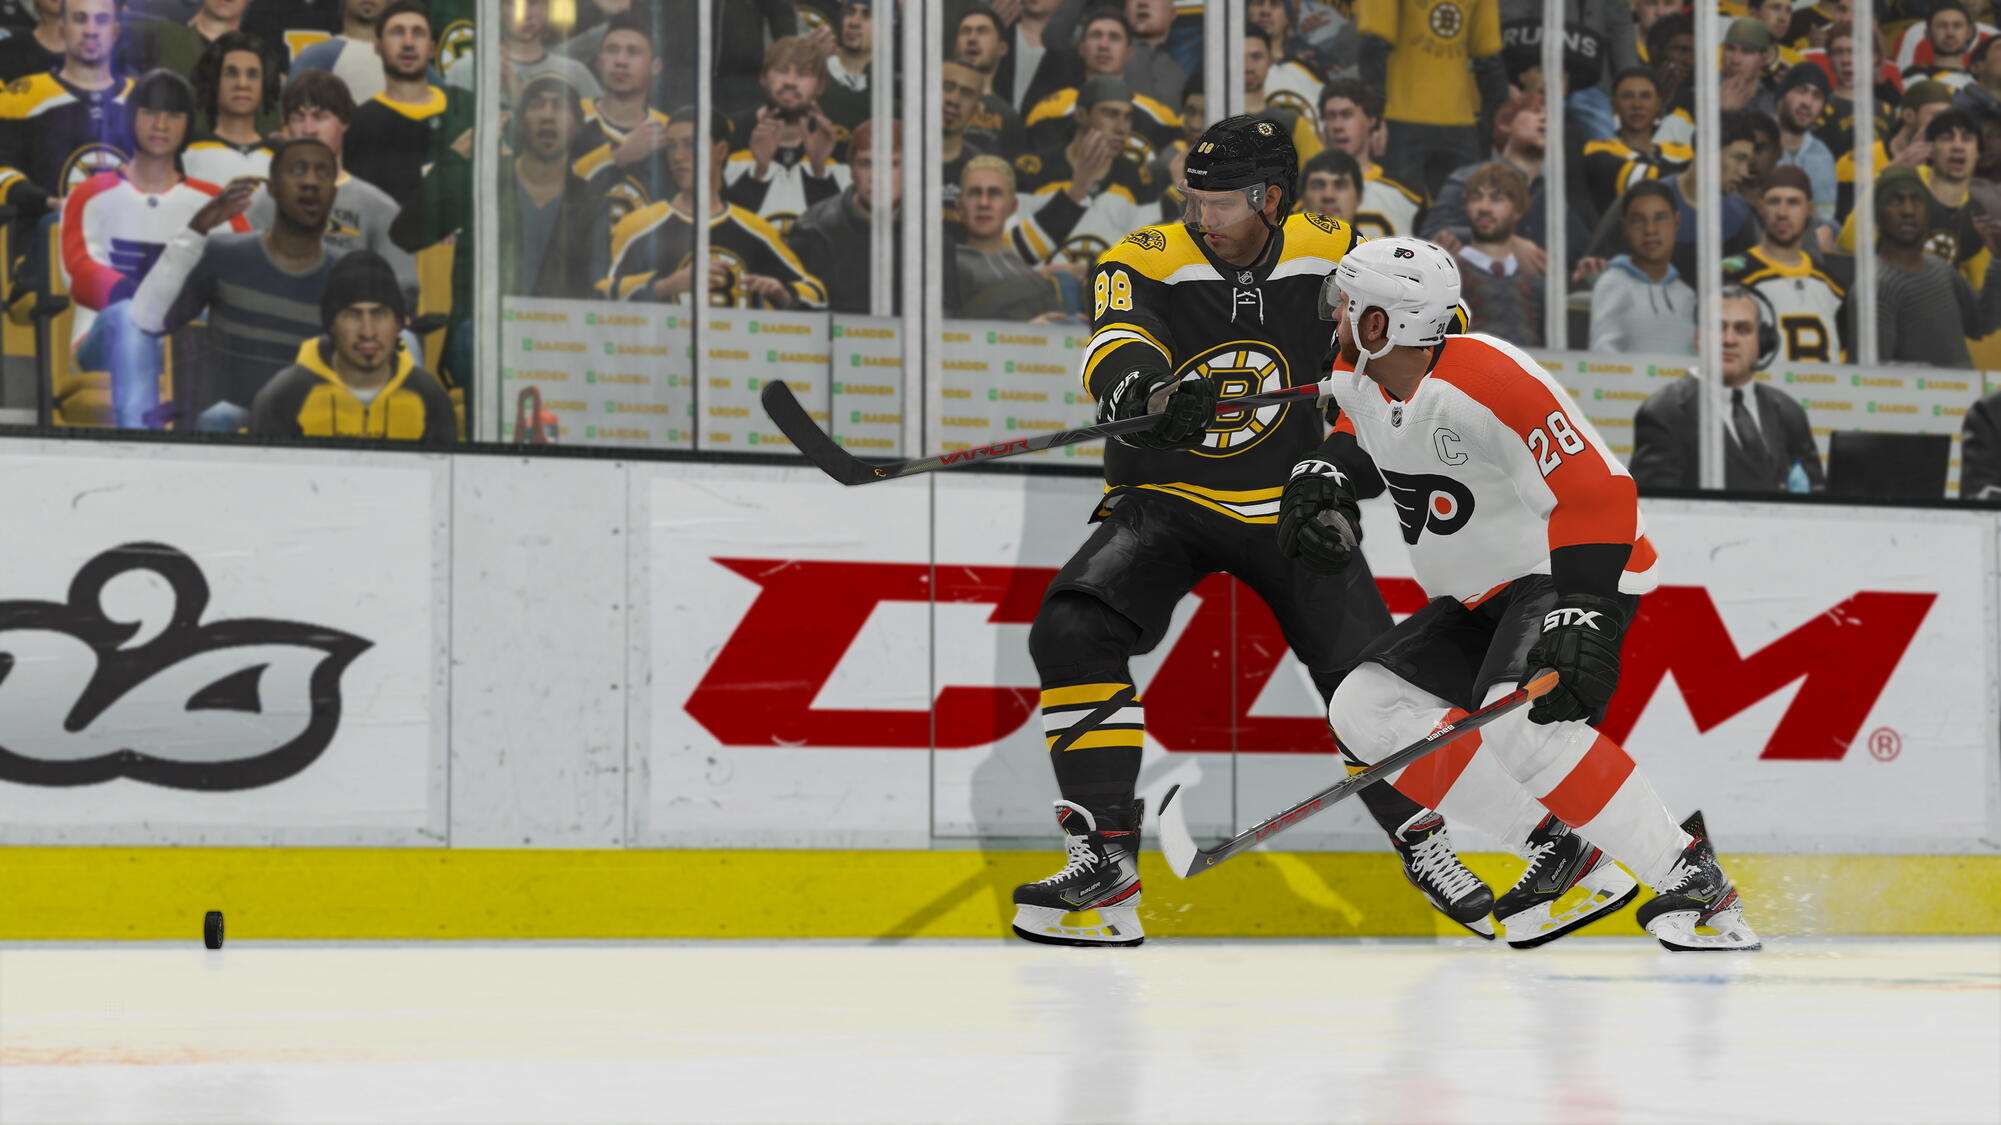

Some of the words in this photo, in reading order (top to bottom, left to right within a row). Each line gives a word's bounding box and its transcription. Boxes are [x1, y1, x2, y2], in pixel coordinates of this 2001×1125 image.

[1095, 269, 1133, 321] 88
[939, 438, 1031, 464] VAPOR
[1433, 427, 1468, 466] C
[1527, 411, 1585, 478] 28
[1289, 459, 1349, 487] STX
[1543, 608, 1604, 632] STX
[1551, 858, 1567, 882] BAUER
[1080, 882, 1101, 896] BAUER
